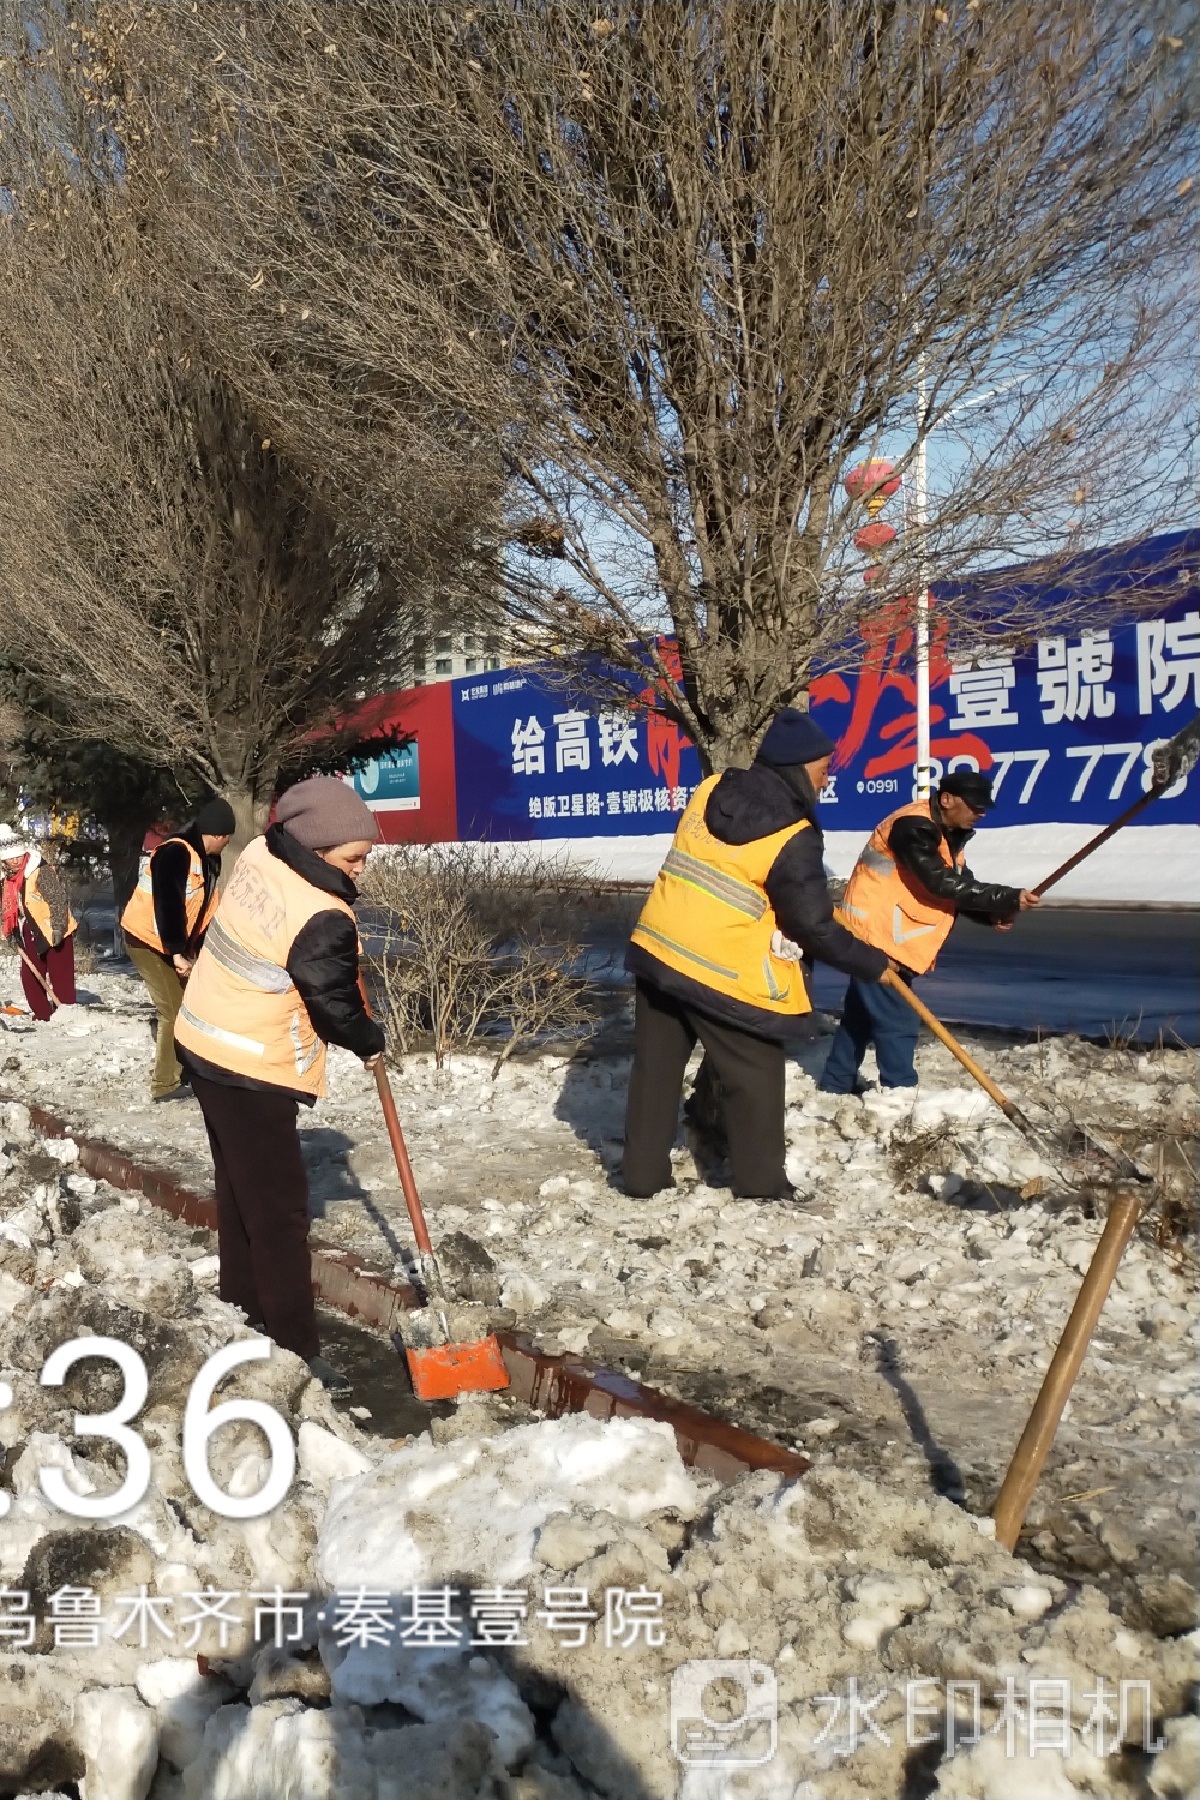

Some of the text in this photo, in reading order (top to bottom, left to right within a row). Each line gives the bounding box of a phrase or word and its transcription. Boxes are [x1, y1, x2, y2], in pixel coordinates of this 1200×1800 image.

[511, 704, 639, 775] 给高铁
[949, 611, 1200, 730] 壹號院
[528, 786, 697, 818] 绝版卫星路·壹號极核资
[866, 779, 899, 793] 0991
